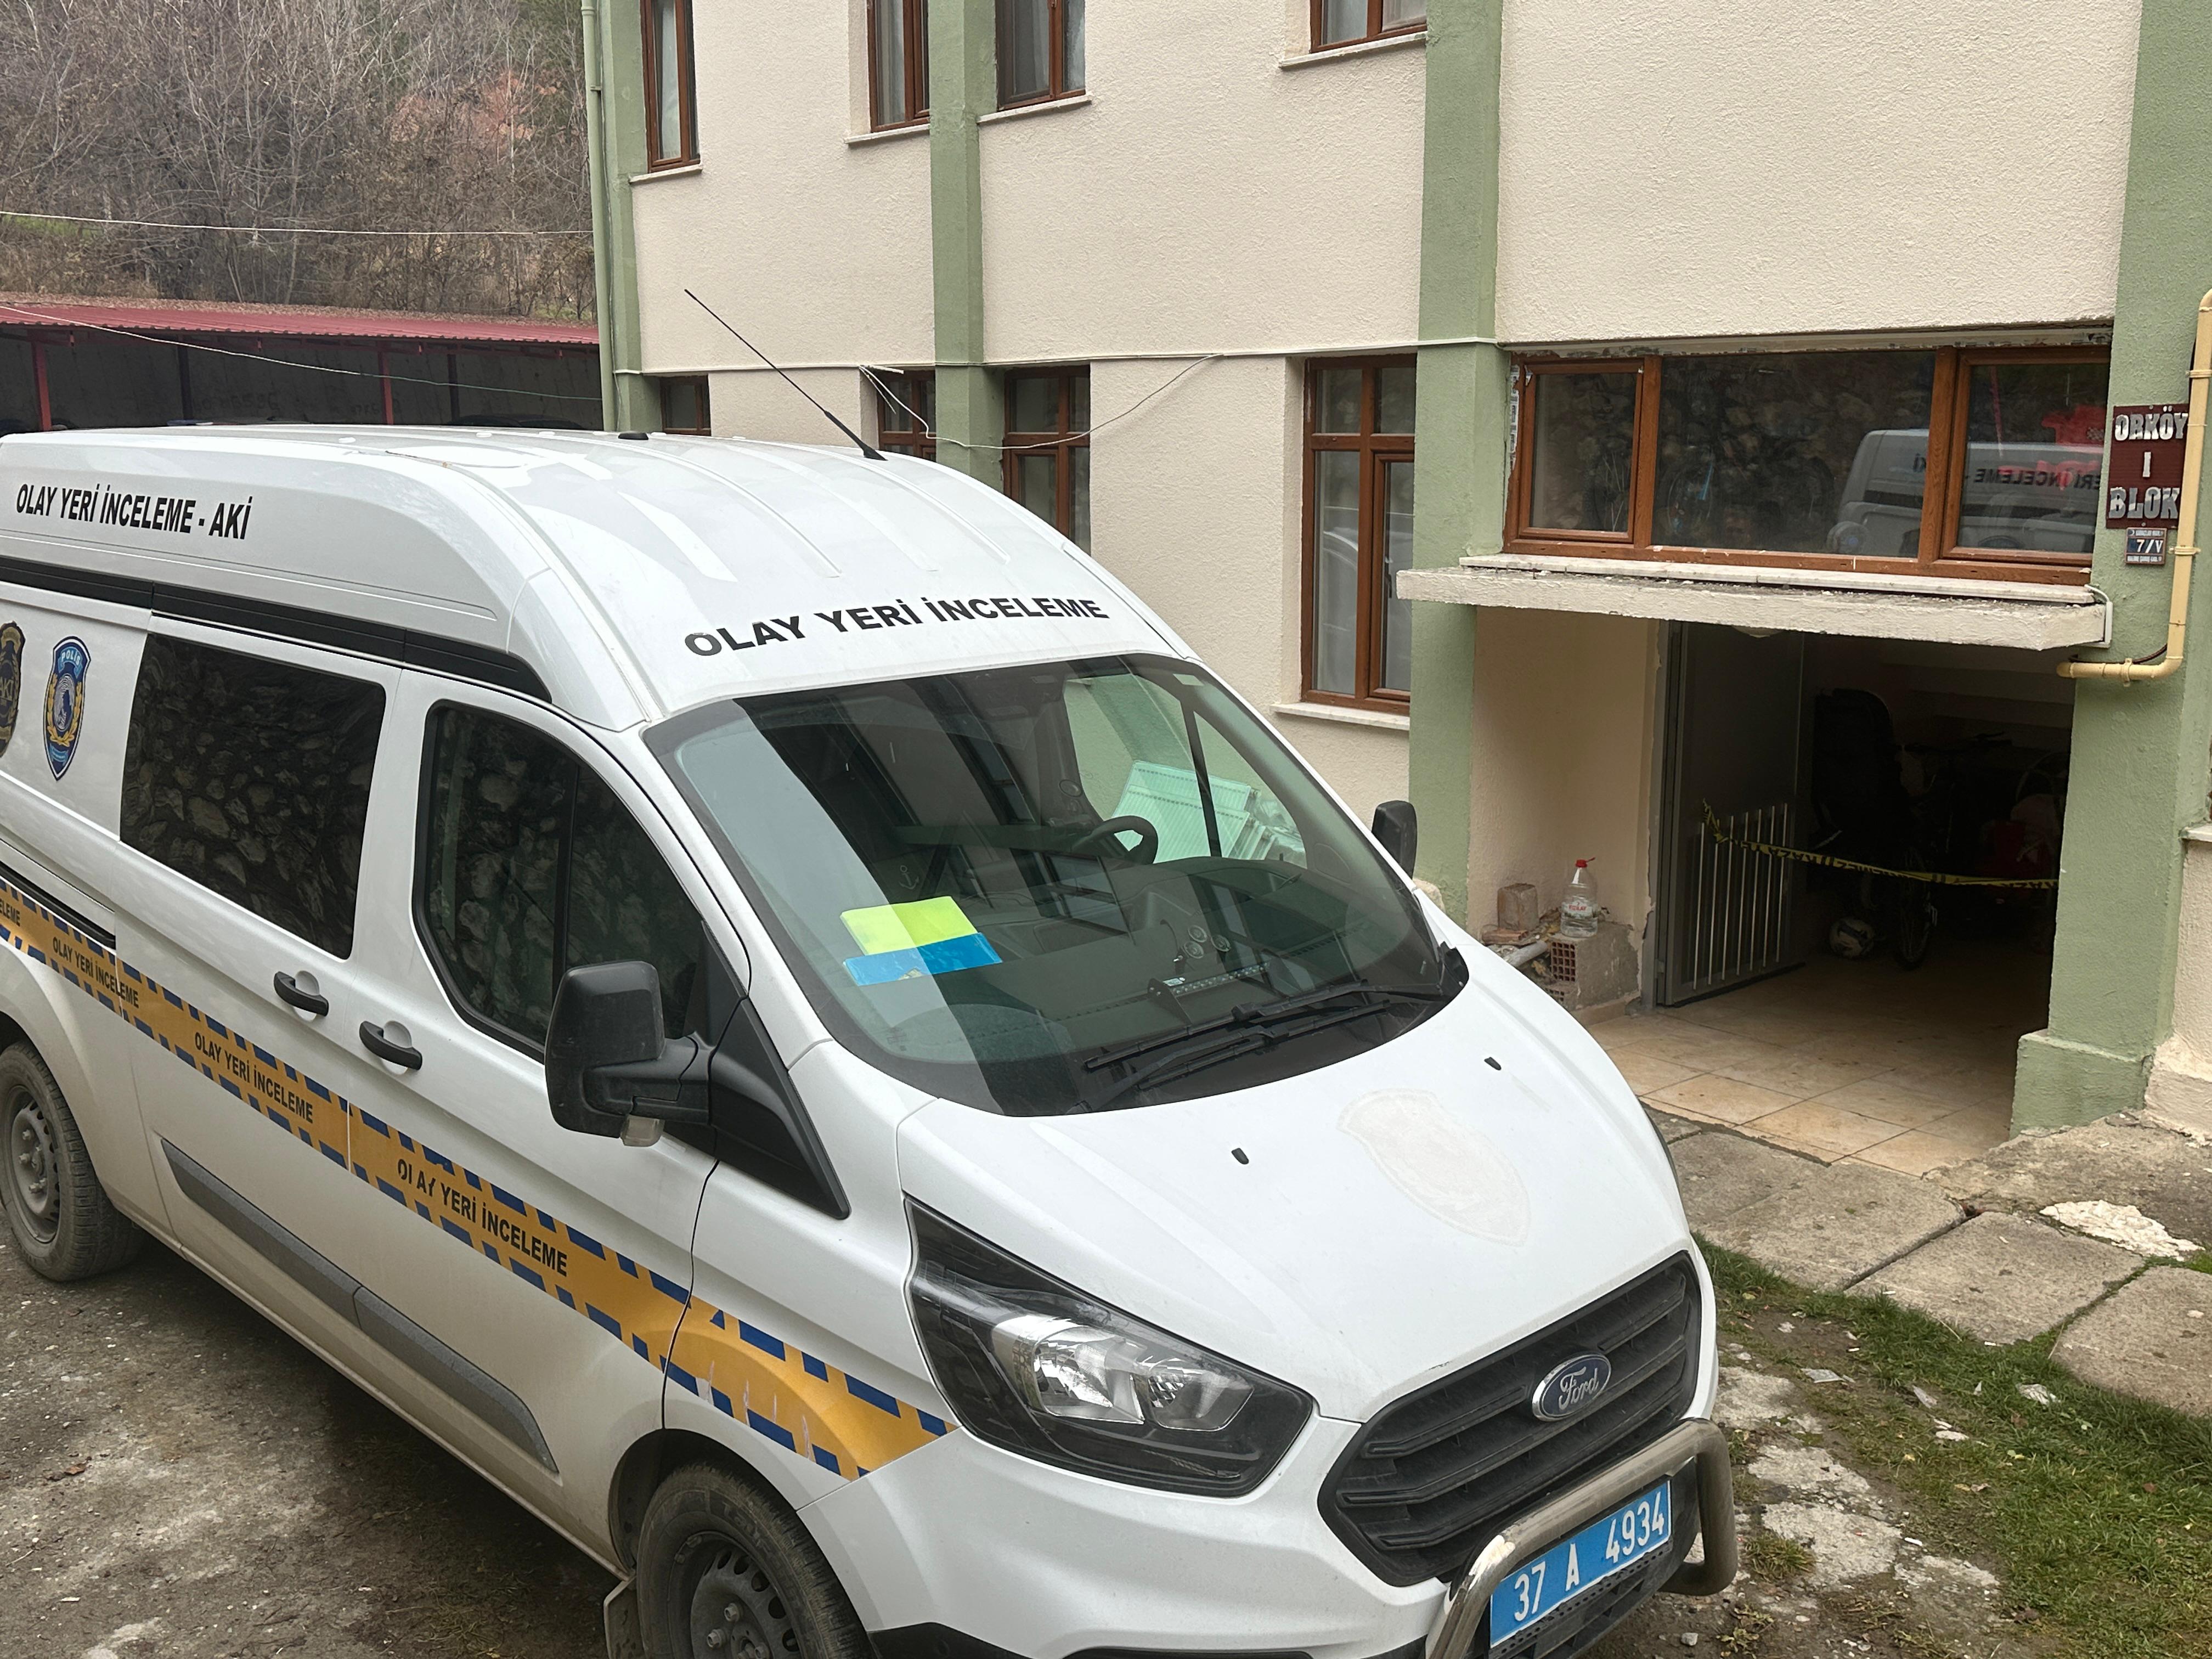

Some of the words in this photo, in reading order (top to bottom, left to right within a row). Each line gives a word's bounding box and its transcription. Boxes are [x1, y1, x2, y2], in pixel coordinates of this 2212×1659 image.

[2115, 405, 2188, 441] ORKÖY
[16, 483, 57, 516] OLAY
[60, 484, 99, 522] YERİ
[99, 484, 196, 533] İNCELEME
[199, 518, 205, 527] -
[208, 496, 253, 540] AKİ
[2108, 486, 2180, 520] BLOK
[2136, 539, 2163, 554] 7/V
[685, 616, 806, 657] OLAY
[815, 599, 922, 633] YERİ
[922, 596, 1110, 623] İNCELEME
[52, 936, 74, 964] OLAY
[75, 953, 93, 975] YERİ
[95, 960, 139, 1008] İNCELEME
[194, 1031, 221, 1063] OLAY
[224, 1050, 251, 1084] YERİ
[253, 1064, 314, 1124] İNCELEME
[440, 1182, 477, 1223] YERİ
[481, 1201, 568, 1277] İNCELEME
[1559, 1366, 1599, 1411] Ford
[1514, 1561, 1546, 1622] 37
[1565, 1543, 1580, 1592] A
[1605, 1491, 1664, 1564] 4934
